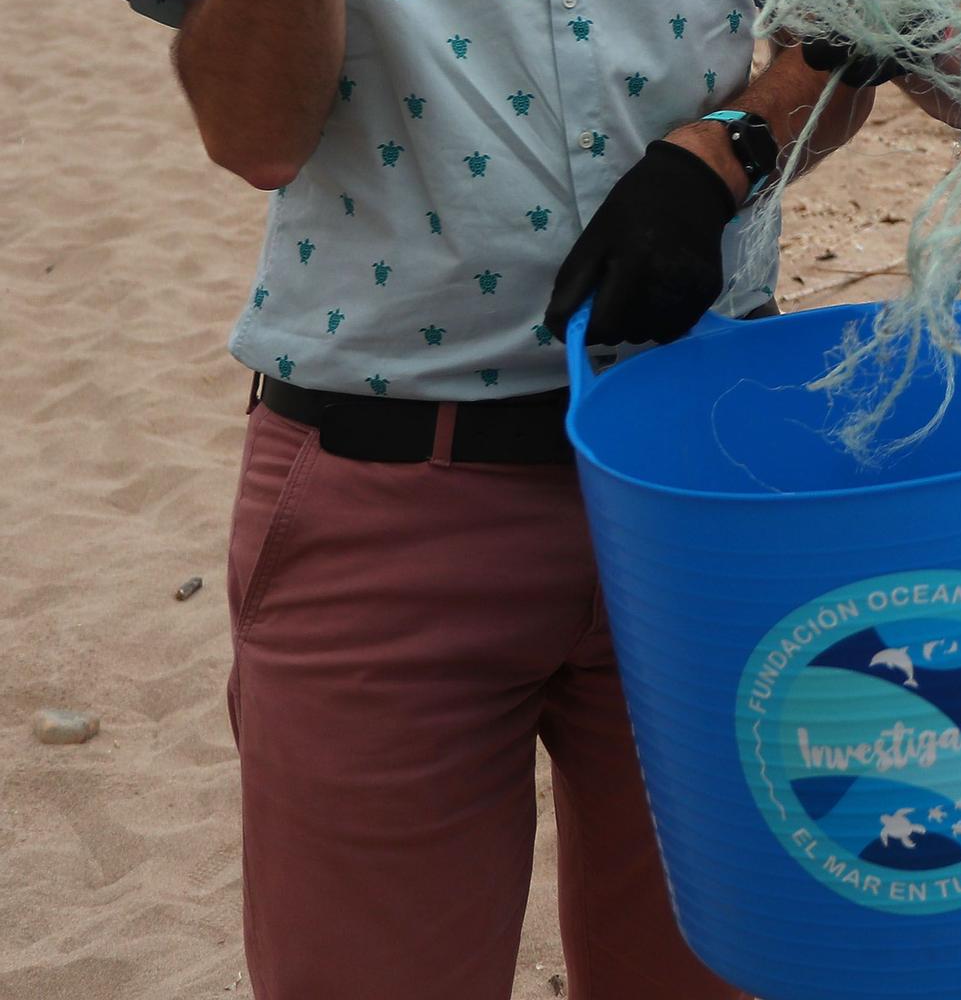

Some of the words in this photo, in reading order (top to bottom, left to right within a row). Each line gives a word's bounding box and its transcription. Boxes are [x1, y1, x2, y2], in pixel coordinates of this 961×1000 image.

[748, 600, 859, 715] FUNDACIÓN
[791, 827, 817, 859] EL
[823, 855, 881, 895] MAR
[889, 882, 928, 902] EN
